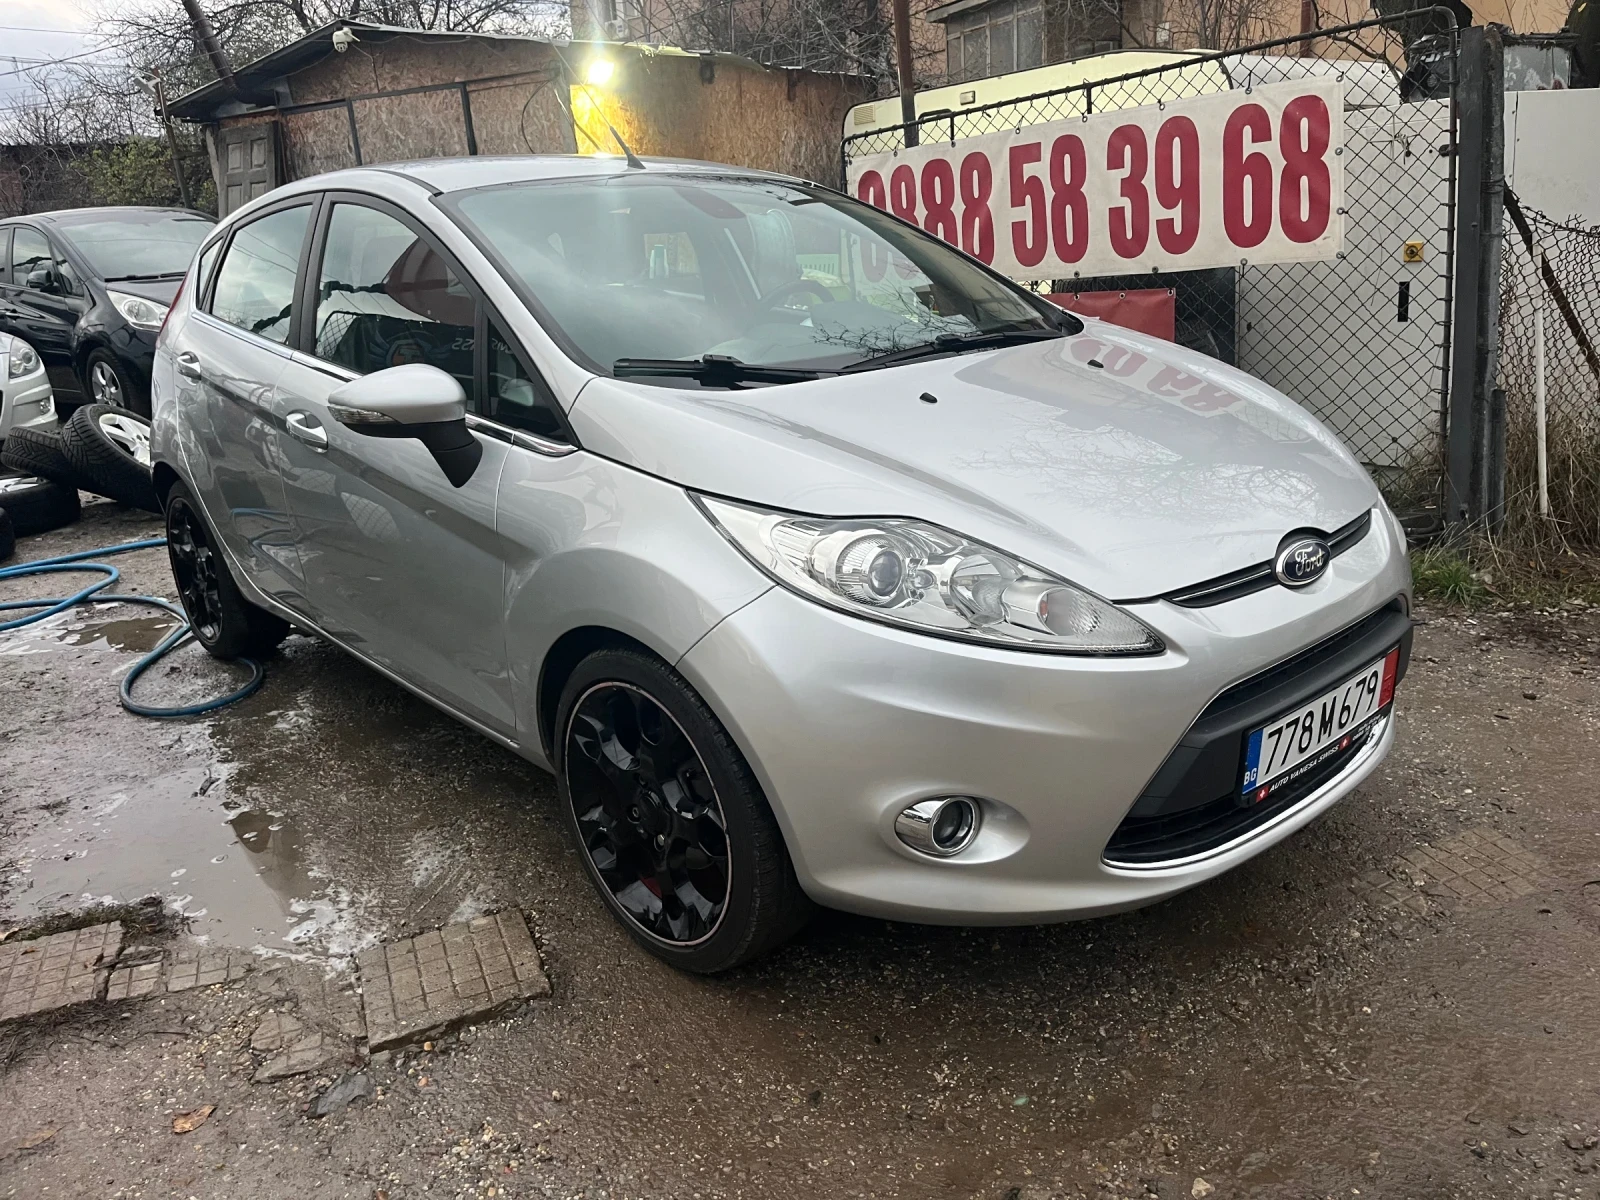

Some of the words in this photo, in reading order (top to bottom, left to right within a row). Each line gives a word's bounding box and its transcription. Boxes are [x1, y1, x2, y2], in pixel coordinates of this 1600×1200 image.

[1008, 134, 1089, 267] 58
[1106, 115, 1200, 259] 39
[1222, 94, 1331, 248] 68
[1294, 546, 1325, 576] Ford
[1243, 767, 1258, 786] BG
[1269, 776, 1289, 793] AUTO
